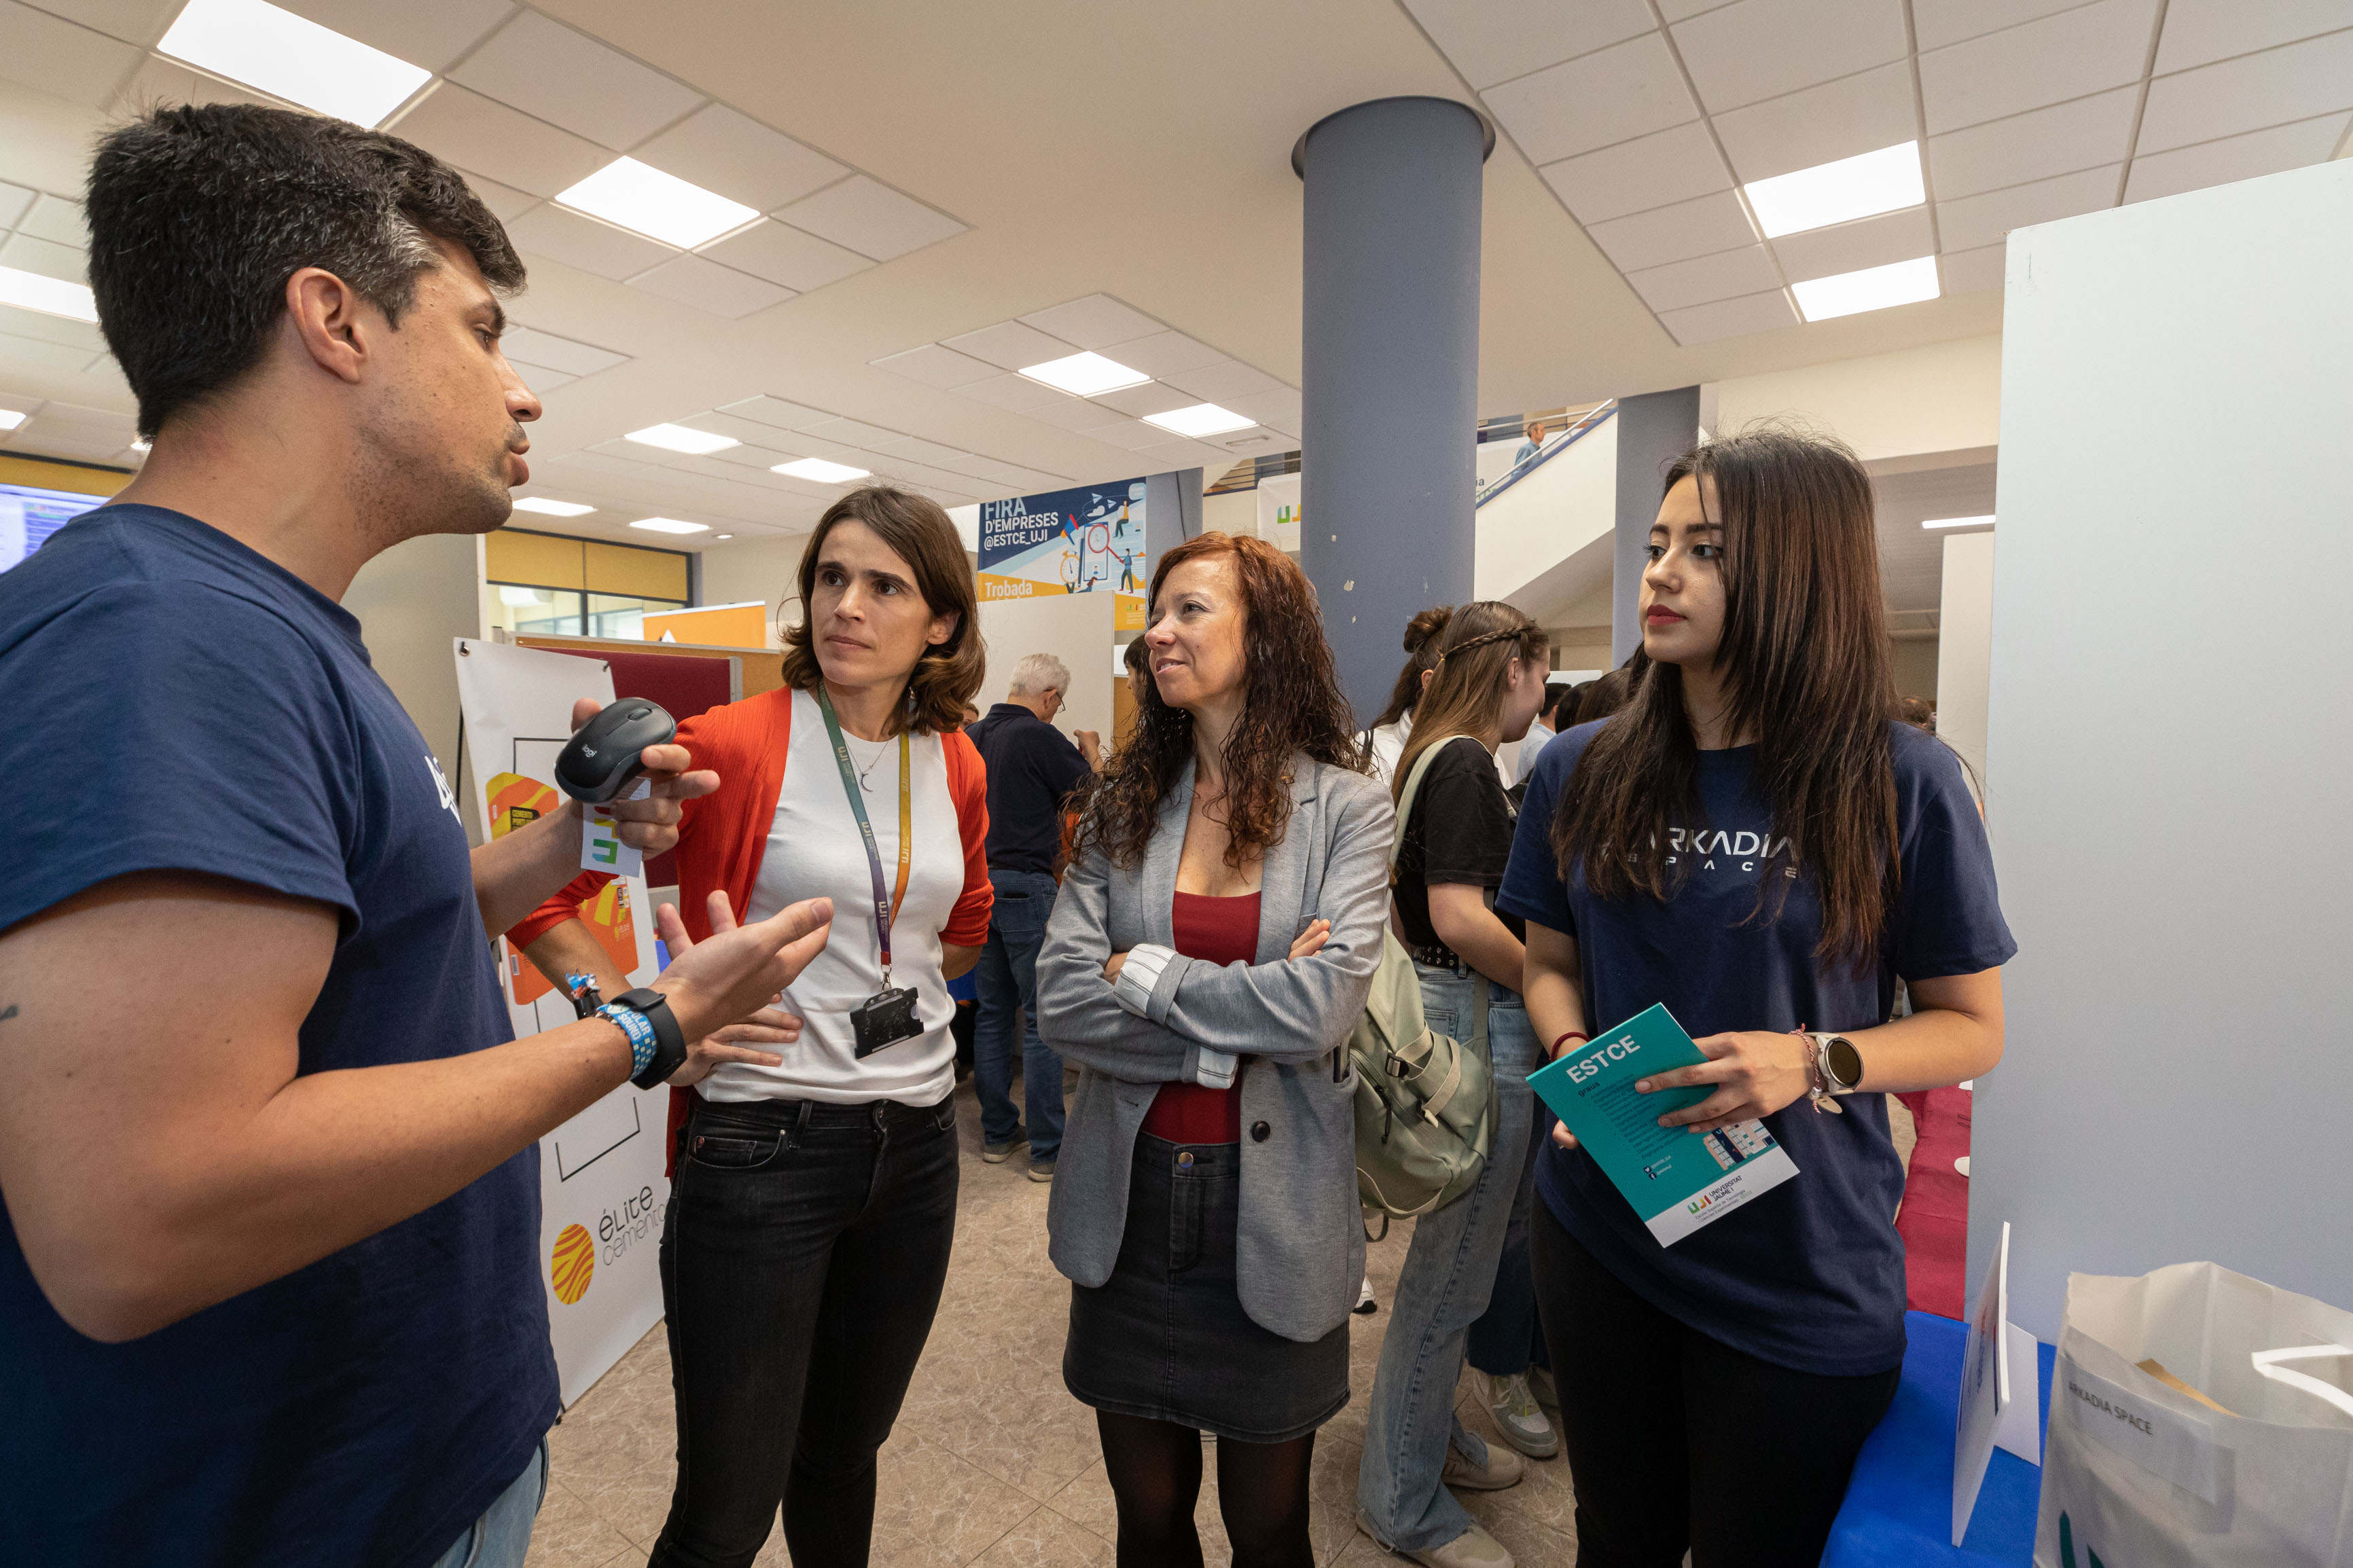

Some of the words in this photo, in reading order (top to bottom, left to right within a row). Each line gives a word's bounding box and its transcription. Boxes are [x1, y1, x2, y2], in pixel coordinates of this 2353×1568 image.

[986, 497, 1027, 519] FIRA
[1278, 505, 1301, 524] UJ
[985, 512, 1058, 534] D'EMPRESES
[984, 529, 1047, 551] @ESTCE_UJI
[985, 579, 1032, 598] Trobada
[582, 744, 597, 758] logi
[1649, 827, 1798, 861] RKADIA
[878, 901, 888, 917] UJI
[618, 1014, 641, 1040] SOUND
[1566, 1034, 1641, 1084] ESTCE
[1578, 1082, 1600, 1097] graus
[1709, 1175, 1742, 1197] UNIVERSITAT
[1714, 1188, 1731, 1201] JAUME
[1687, 1195, 1712, 1214] UJI
[603, 1199, 669, 1266] cemento
[2069, 1381, 2113, 1415] ARKADIA
[2114, 1406, 2153, 1436] SPACE
